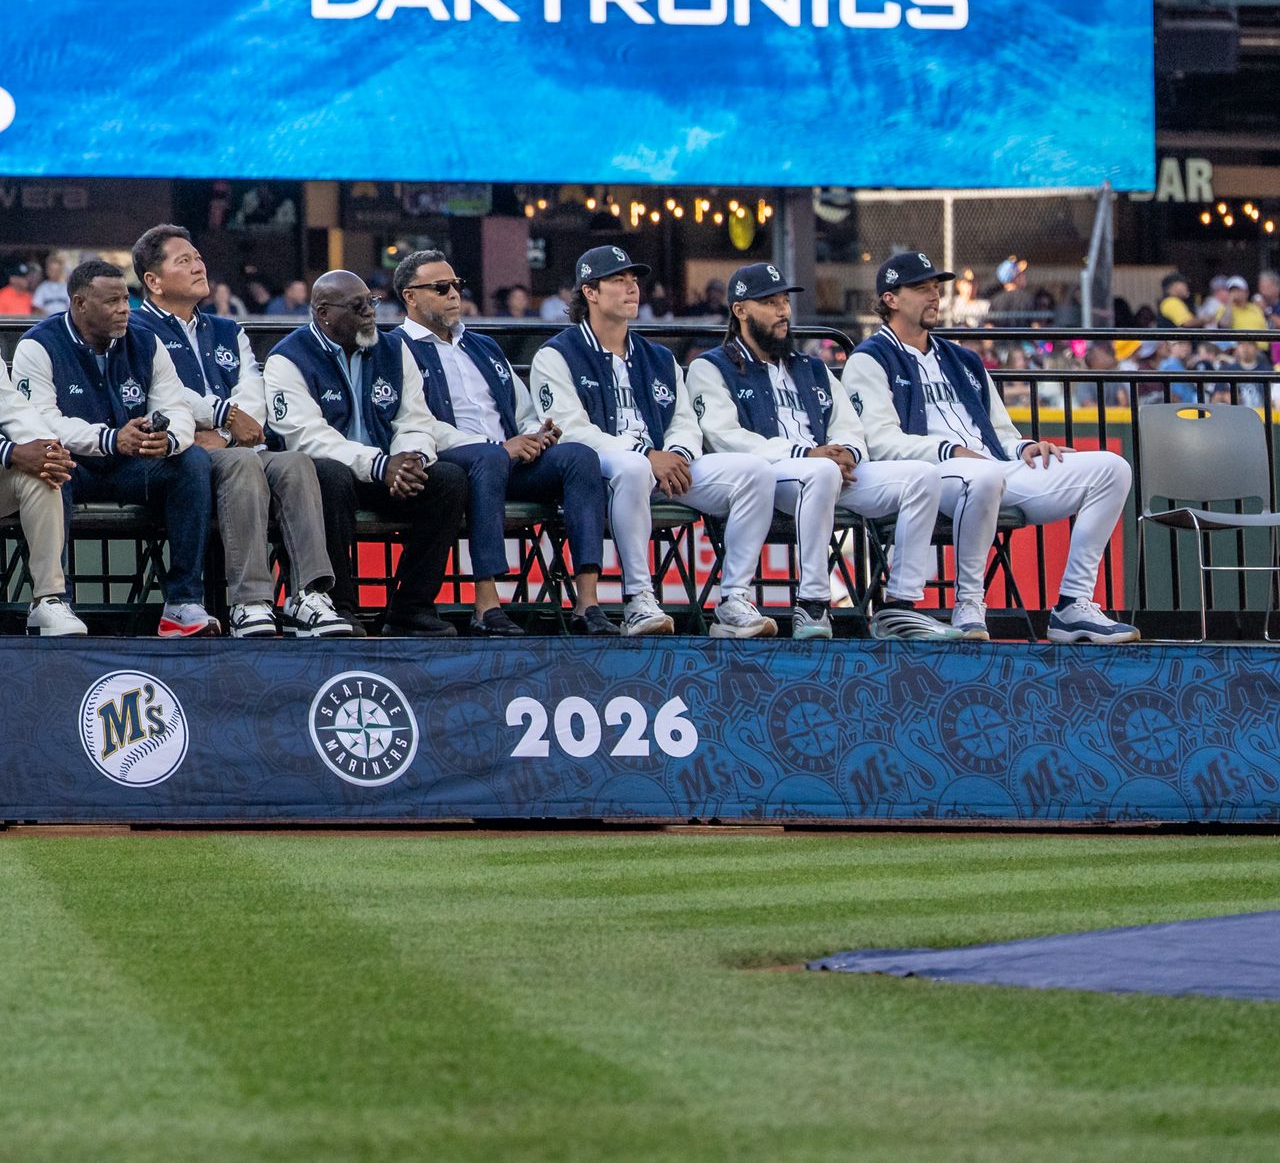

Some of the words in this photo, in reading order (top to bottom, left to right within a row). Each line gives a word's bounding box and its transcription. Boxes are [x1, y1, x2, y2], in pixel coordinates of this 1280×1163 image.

[218, 351, 233, 363] 50
[68, 384, 84, 395] Ken
[123, 386, 140, 398] 50
[320, 389, 343, 401] Mark
[375, 386, 392, 397] 50
[654, 386, 669, 397] 50
[737, 389, 755, 399] J.P.
[321, 680, 402, 717] SEATTLE
[98, 683, 167, 762] M's
[505, 695, 699, 758] 2026
[324, 735, 408, 776] MARINERS
